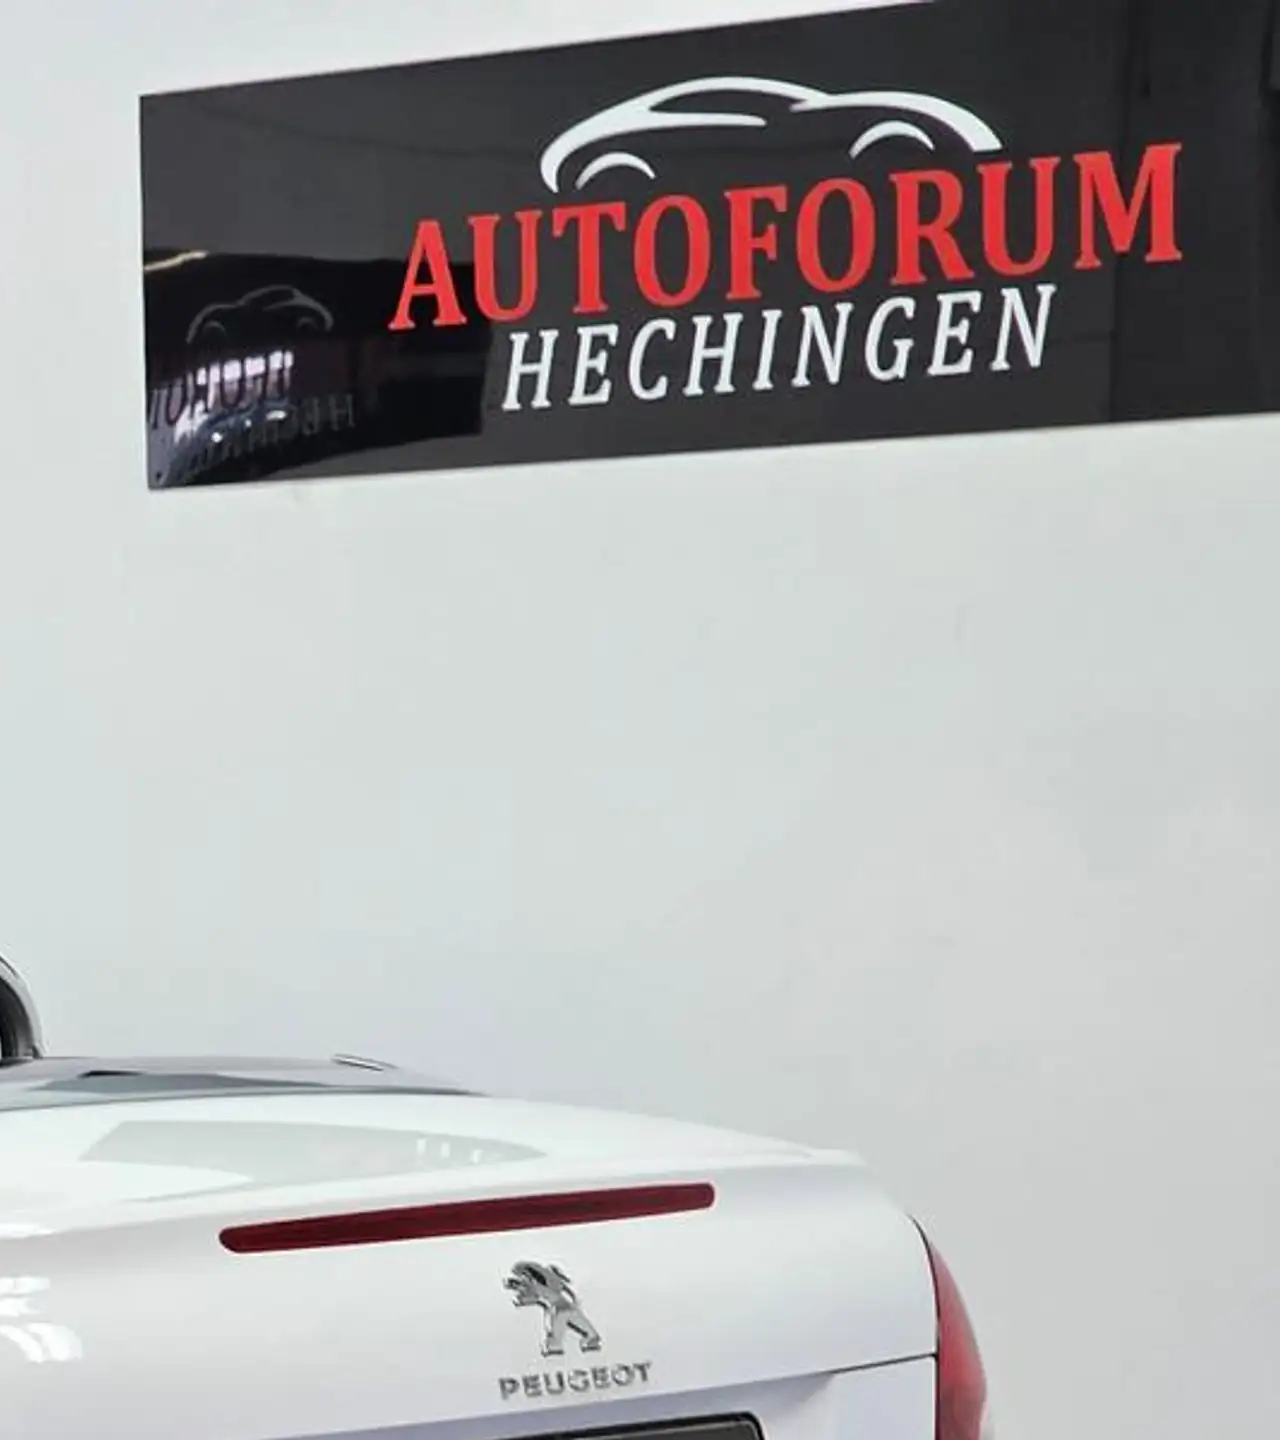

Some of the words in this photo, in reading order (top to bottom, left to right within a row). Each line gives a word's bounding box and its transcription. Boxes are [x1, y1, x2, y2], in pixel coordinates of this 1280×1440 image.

[388, 142, 1181, 332] AUTOFORUM
[500, 283, 1058, 412] HECHINGEN
[497, 1360, 652, 1400] PEUGEOT
